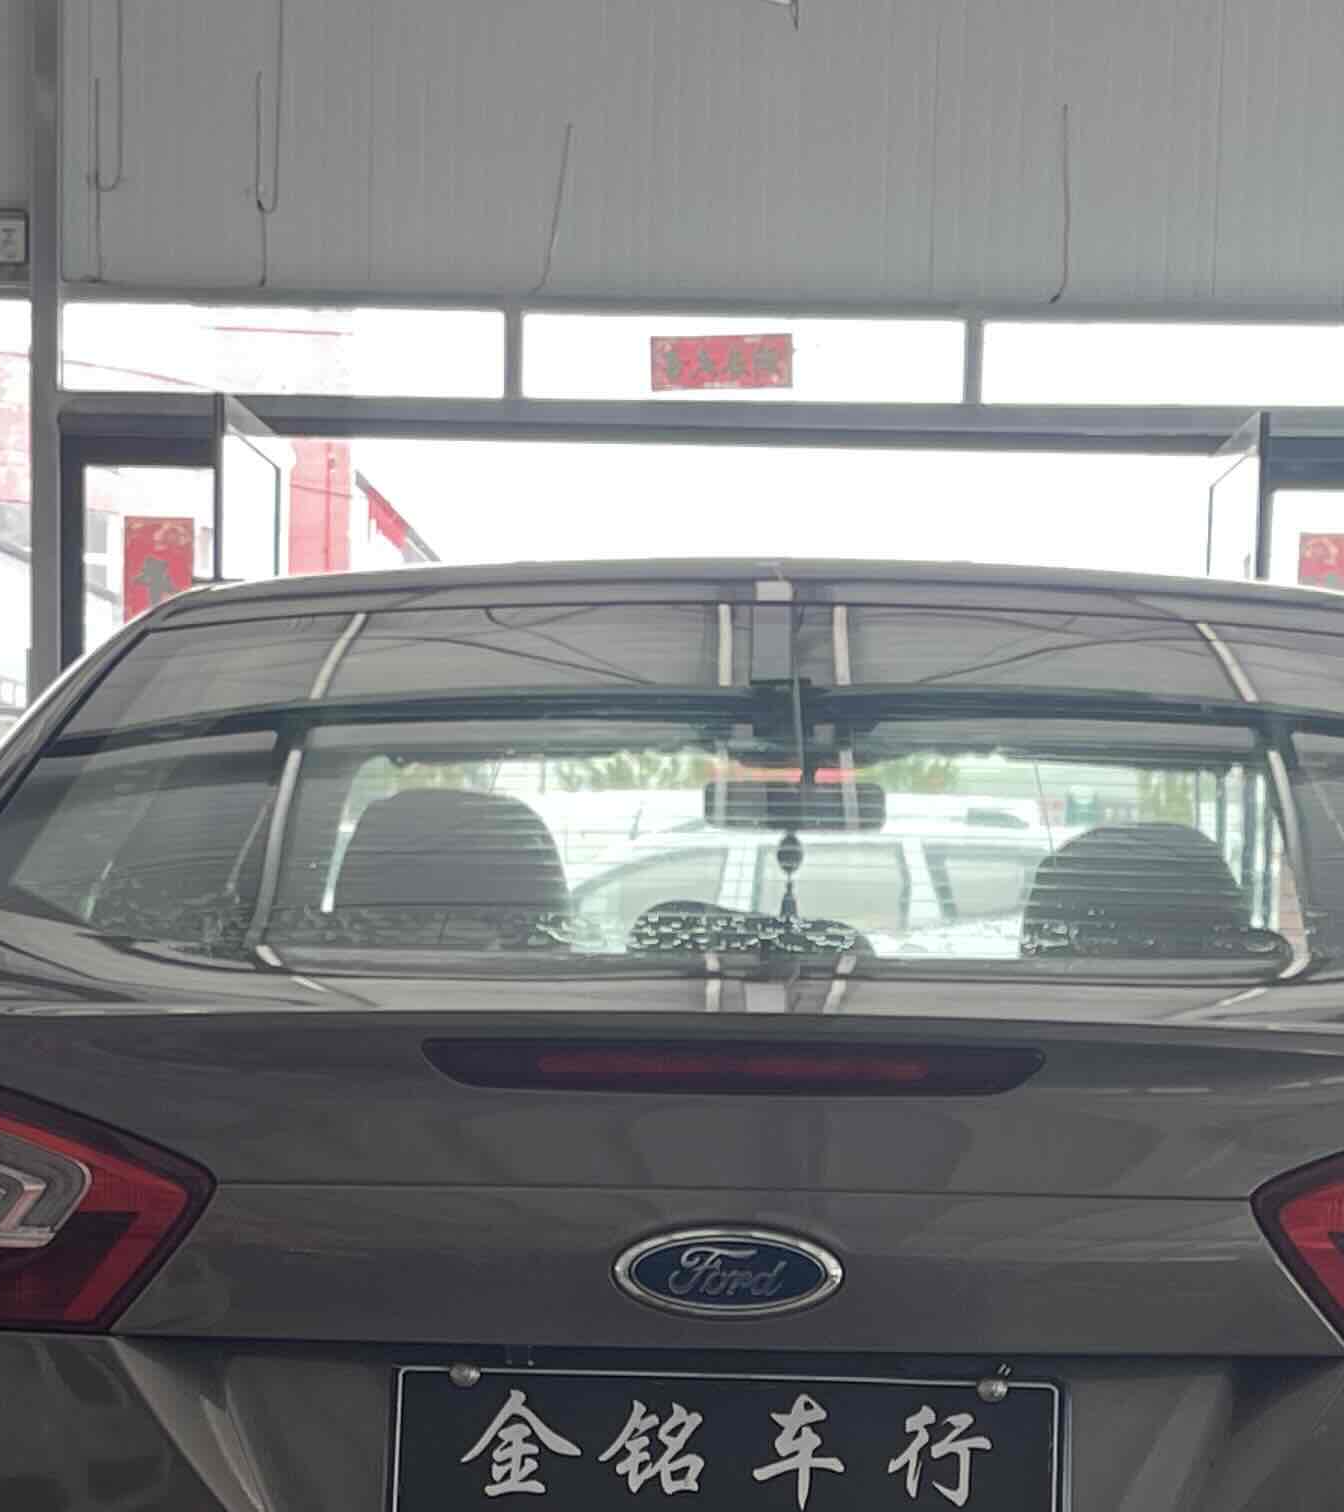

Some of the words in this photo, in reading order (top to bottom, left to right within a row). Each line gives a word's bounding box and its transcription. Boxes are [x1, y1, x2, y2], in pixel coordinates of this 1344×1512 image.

[668, 1246, 787, 1297] Ford
[460, 1389, 993, 1512] 金铭车行
